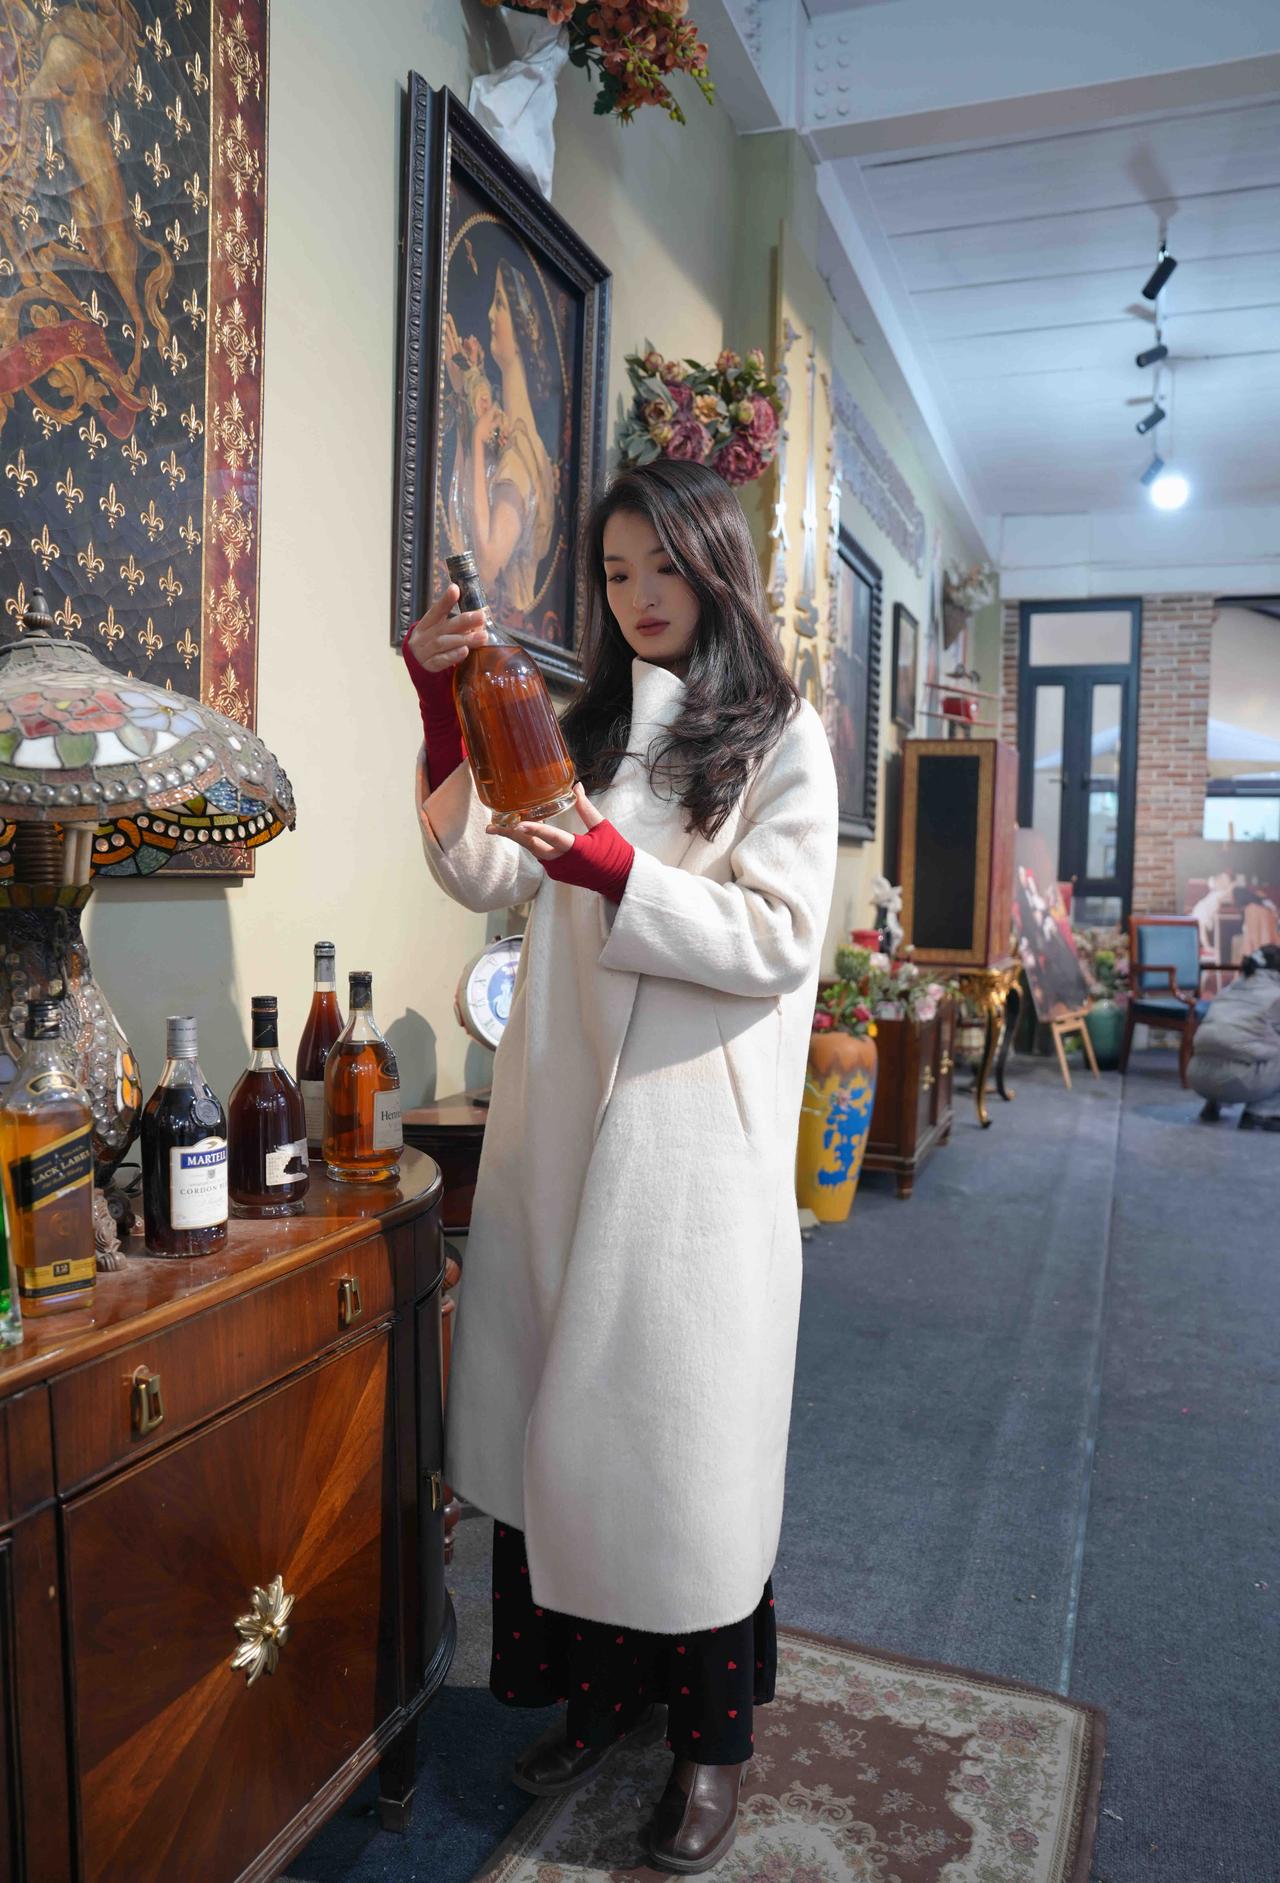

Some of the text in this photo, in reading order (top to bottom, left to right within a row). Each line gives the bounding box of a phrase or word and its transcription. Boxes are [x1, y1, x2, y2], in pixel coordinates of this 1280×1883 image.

[187, 1150, 226, 1167] MARTELL
[30, 1166, 60, 1185] LACK
[180, 1185, 217, 1196] CORDON
